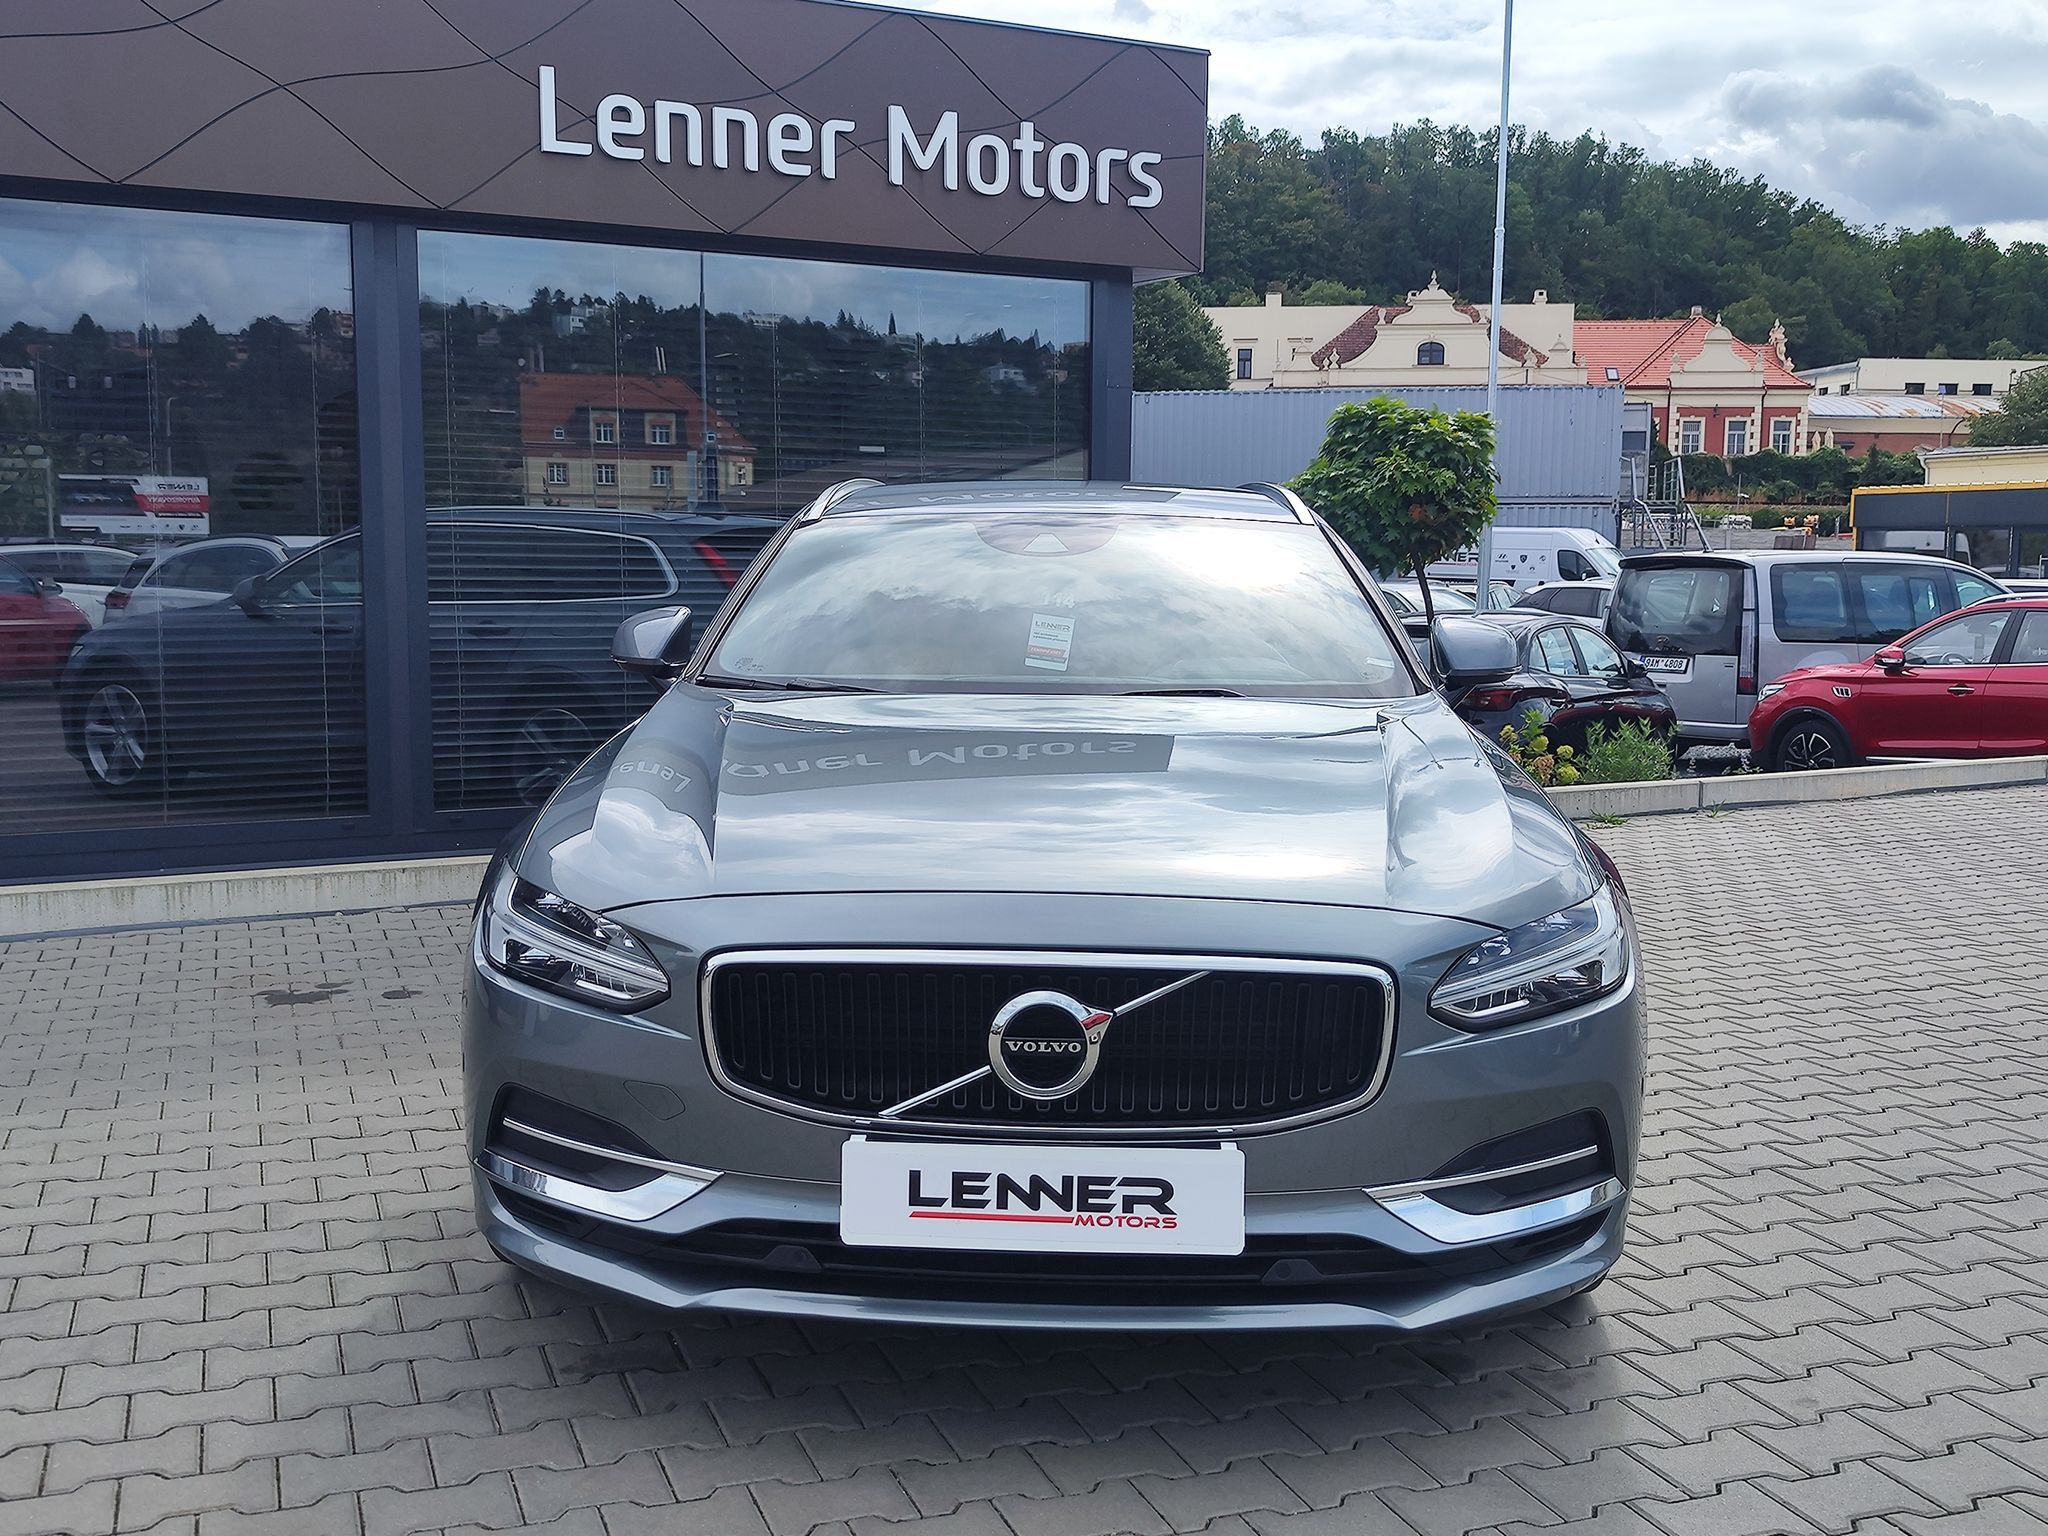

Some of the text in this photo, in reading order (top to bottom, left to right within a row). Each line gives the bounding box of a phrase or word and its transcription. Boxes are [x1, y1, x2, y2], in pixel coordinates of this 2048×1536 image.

[538, 64, 1164, 209] Lenner Motors
[1005, 1040, 1082, 1053] VOLVO
[908, 1169, 1178, 1216] LENNER
[1074, 1215, 1178, 1229] MOTORS
